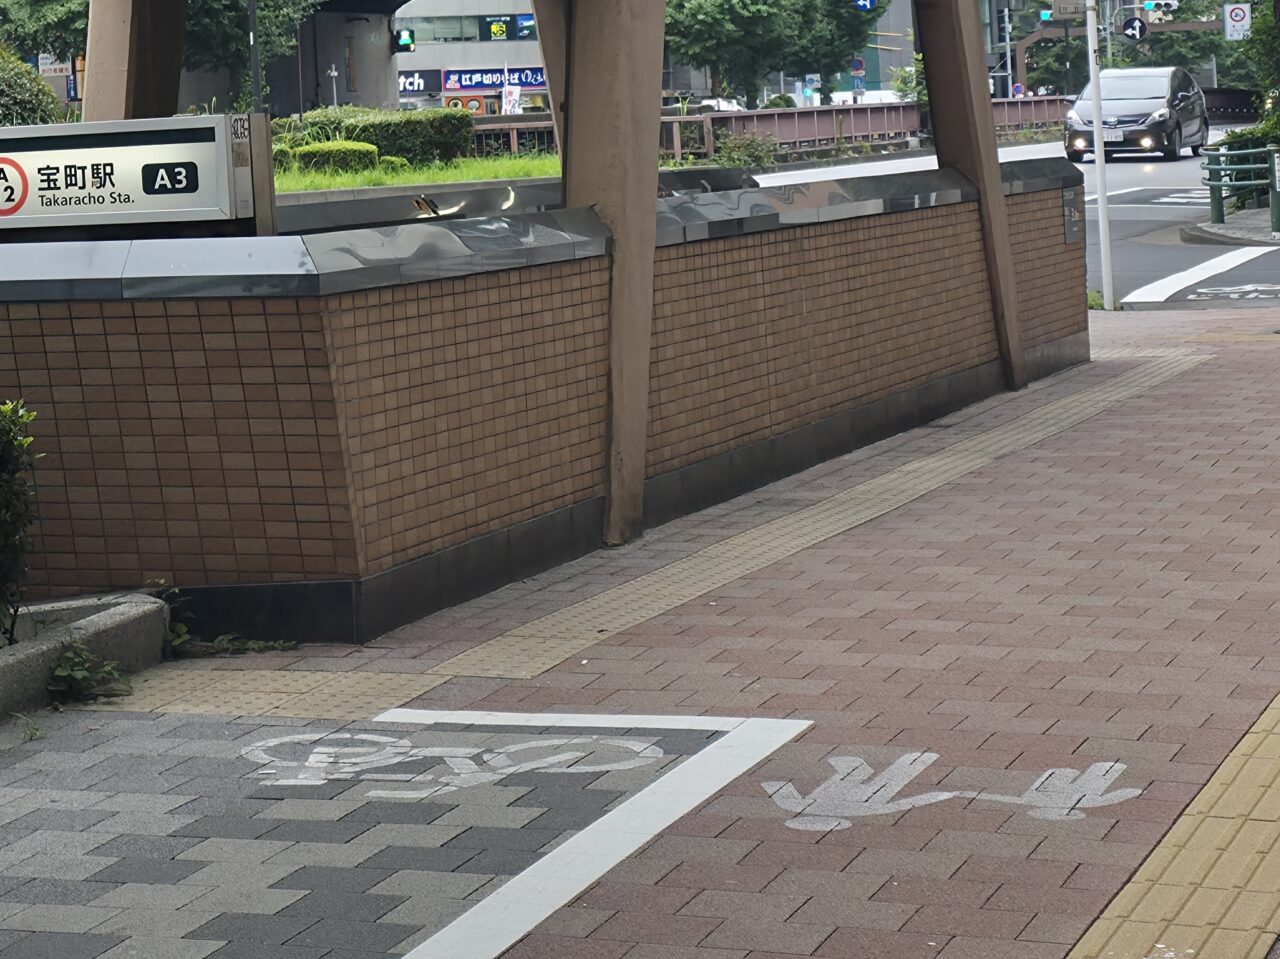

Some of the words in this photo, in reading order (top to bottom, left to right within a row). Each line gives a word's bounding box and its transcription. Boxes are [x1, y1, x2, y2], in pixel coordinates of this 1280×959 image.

[37, 162, 116, 193] 宝町駅
[154, 167, 188, 190] A3
[38, 192, 106, 208] Takaracho
[109, 191, 135, 205] Sta.
